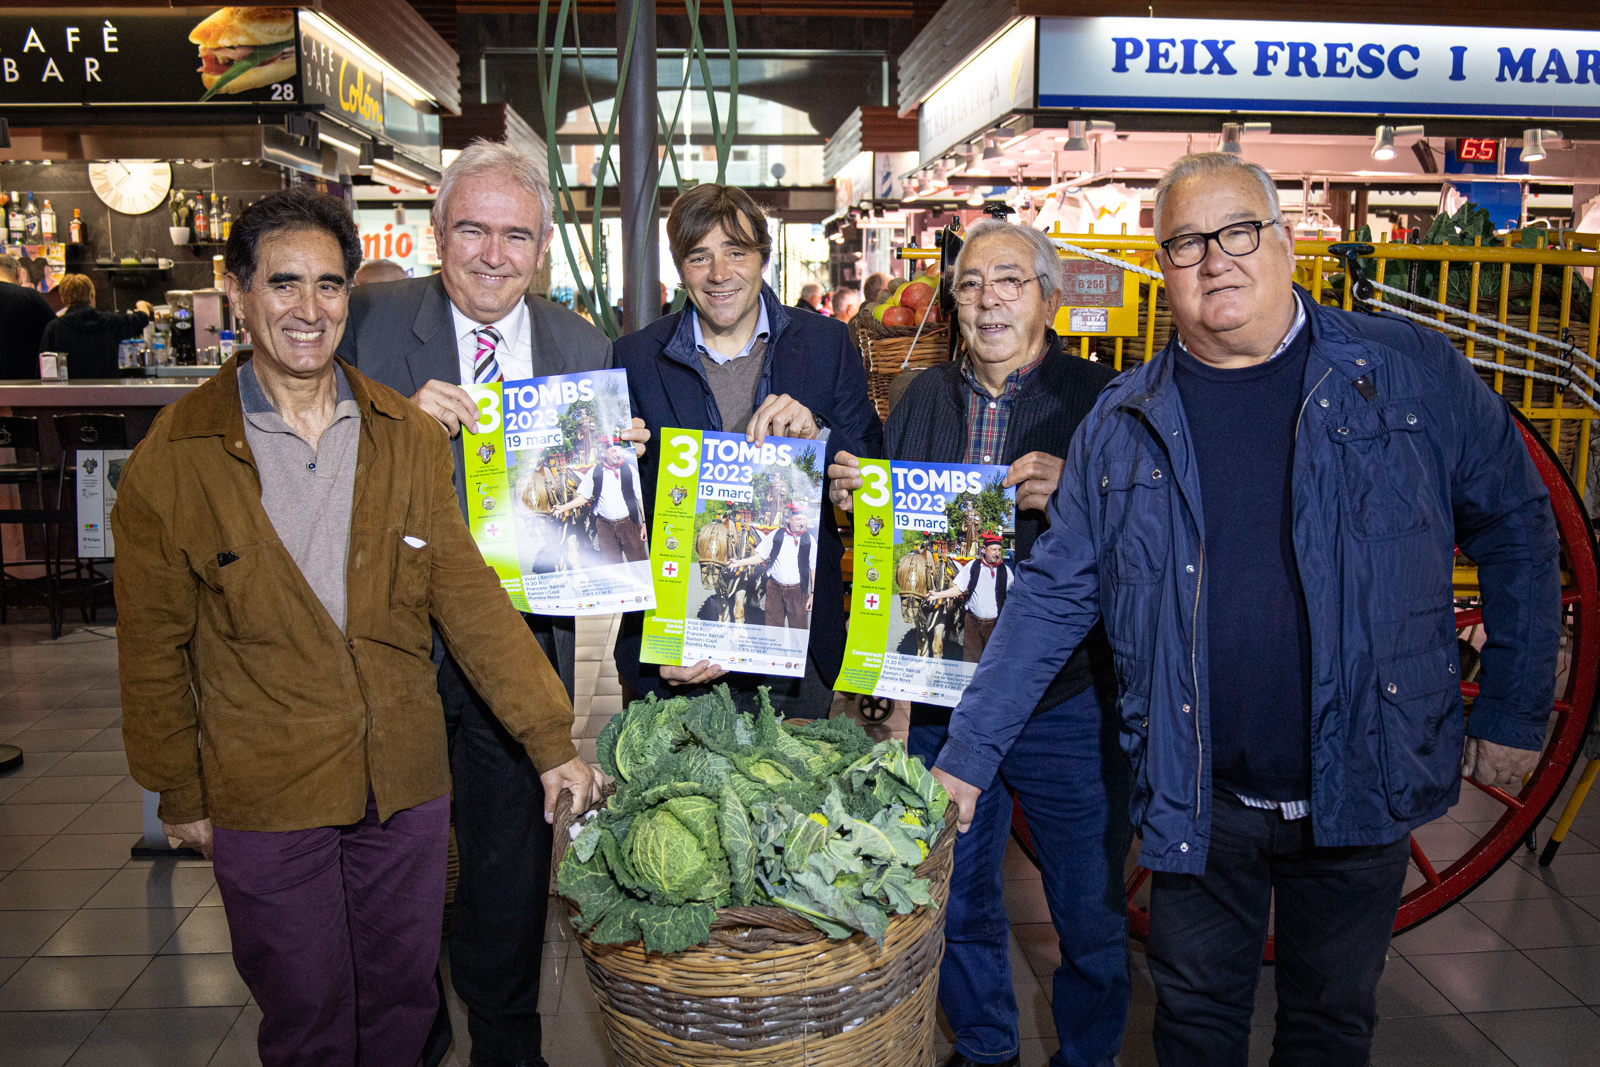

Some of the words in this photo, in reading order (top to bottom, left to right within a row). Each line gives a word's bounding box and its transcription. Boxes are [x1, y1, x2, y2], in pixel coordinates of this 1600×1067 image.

[0, 20, 119, 53] AFÈ
[3, 57, 102, 82] BAR
[1111, 37, 1237, 76] PEIX
[1252, 40, 1420, 81] FRESC
[1448, 46, 1467, 81] I
[1495, 47, 1600, 85] MAR
[271, 83, 294, 100] 28
[306, 63, 331, 97] BAR
[339, 56, 383, 123] Colón
[1461, 139, 1495, 159] 65
[355, 223, 413, 260] nio
[474, 389, 501, 434] 3
[504, 379, 595, 410] TOMBS
[505, 409, 559, 431] 2023
[506, 436, 522, 448] 19
[526, 432, 562, 447] març
[666, 435, 699, 477] 3
[704, 438, 792, 466] TOMBS
[701, 463, 753, 483] 2023
[700, 485, 714, 496] 19
[718, 487, 751, 502] març
[860, 465, 890, 507] 3
[892, 467, 982, 495] TOMBS
[895, 492, 946, 512] 2023
[896, 514, 909, 526] 19
[913, 517, 946, 533] març
